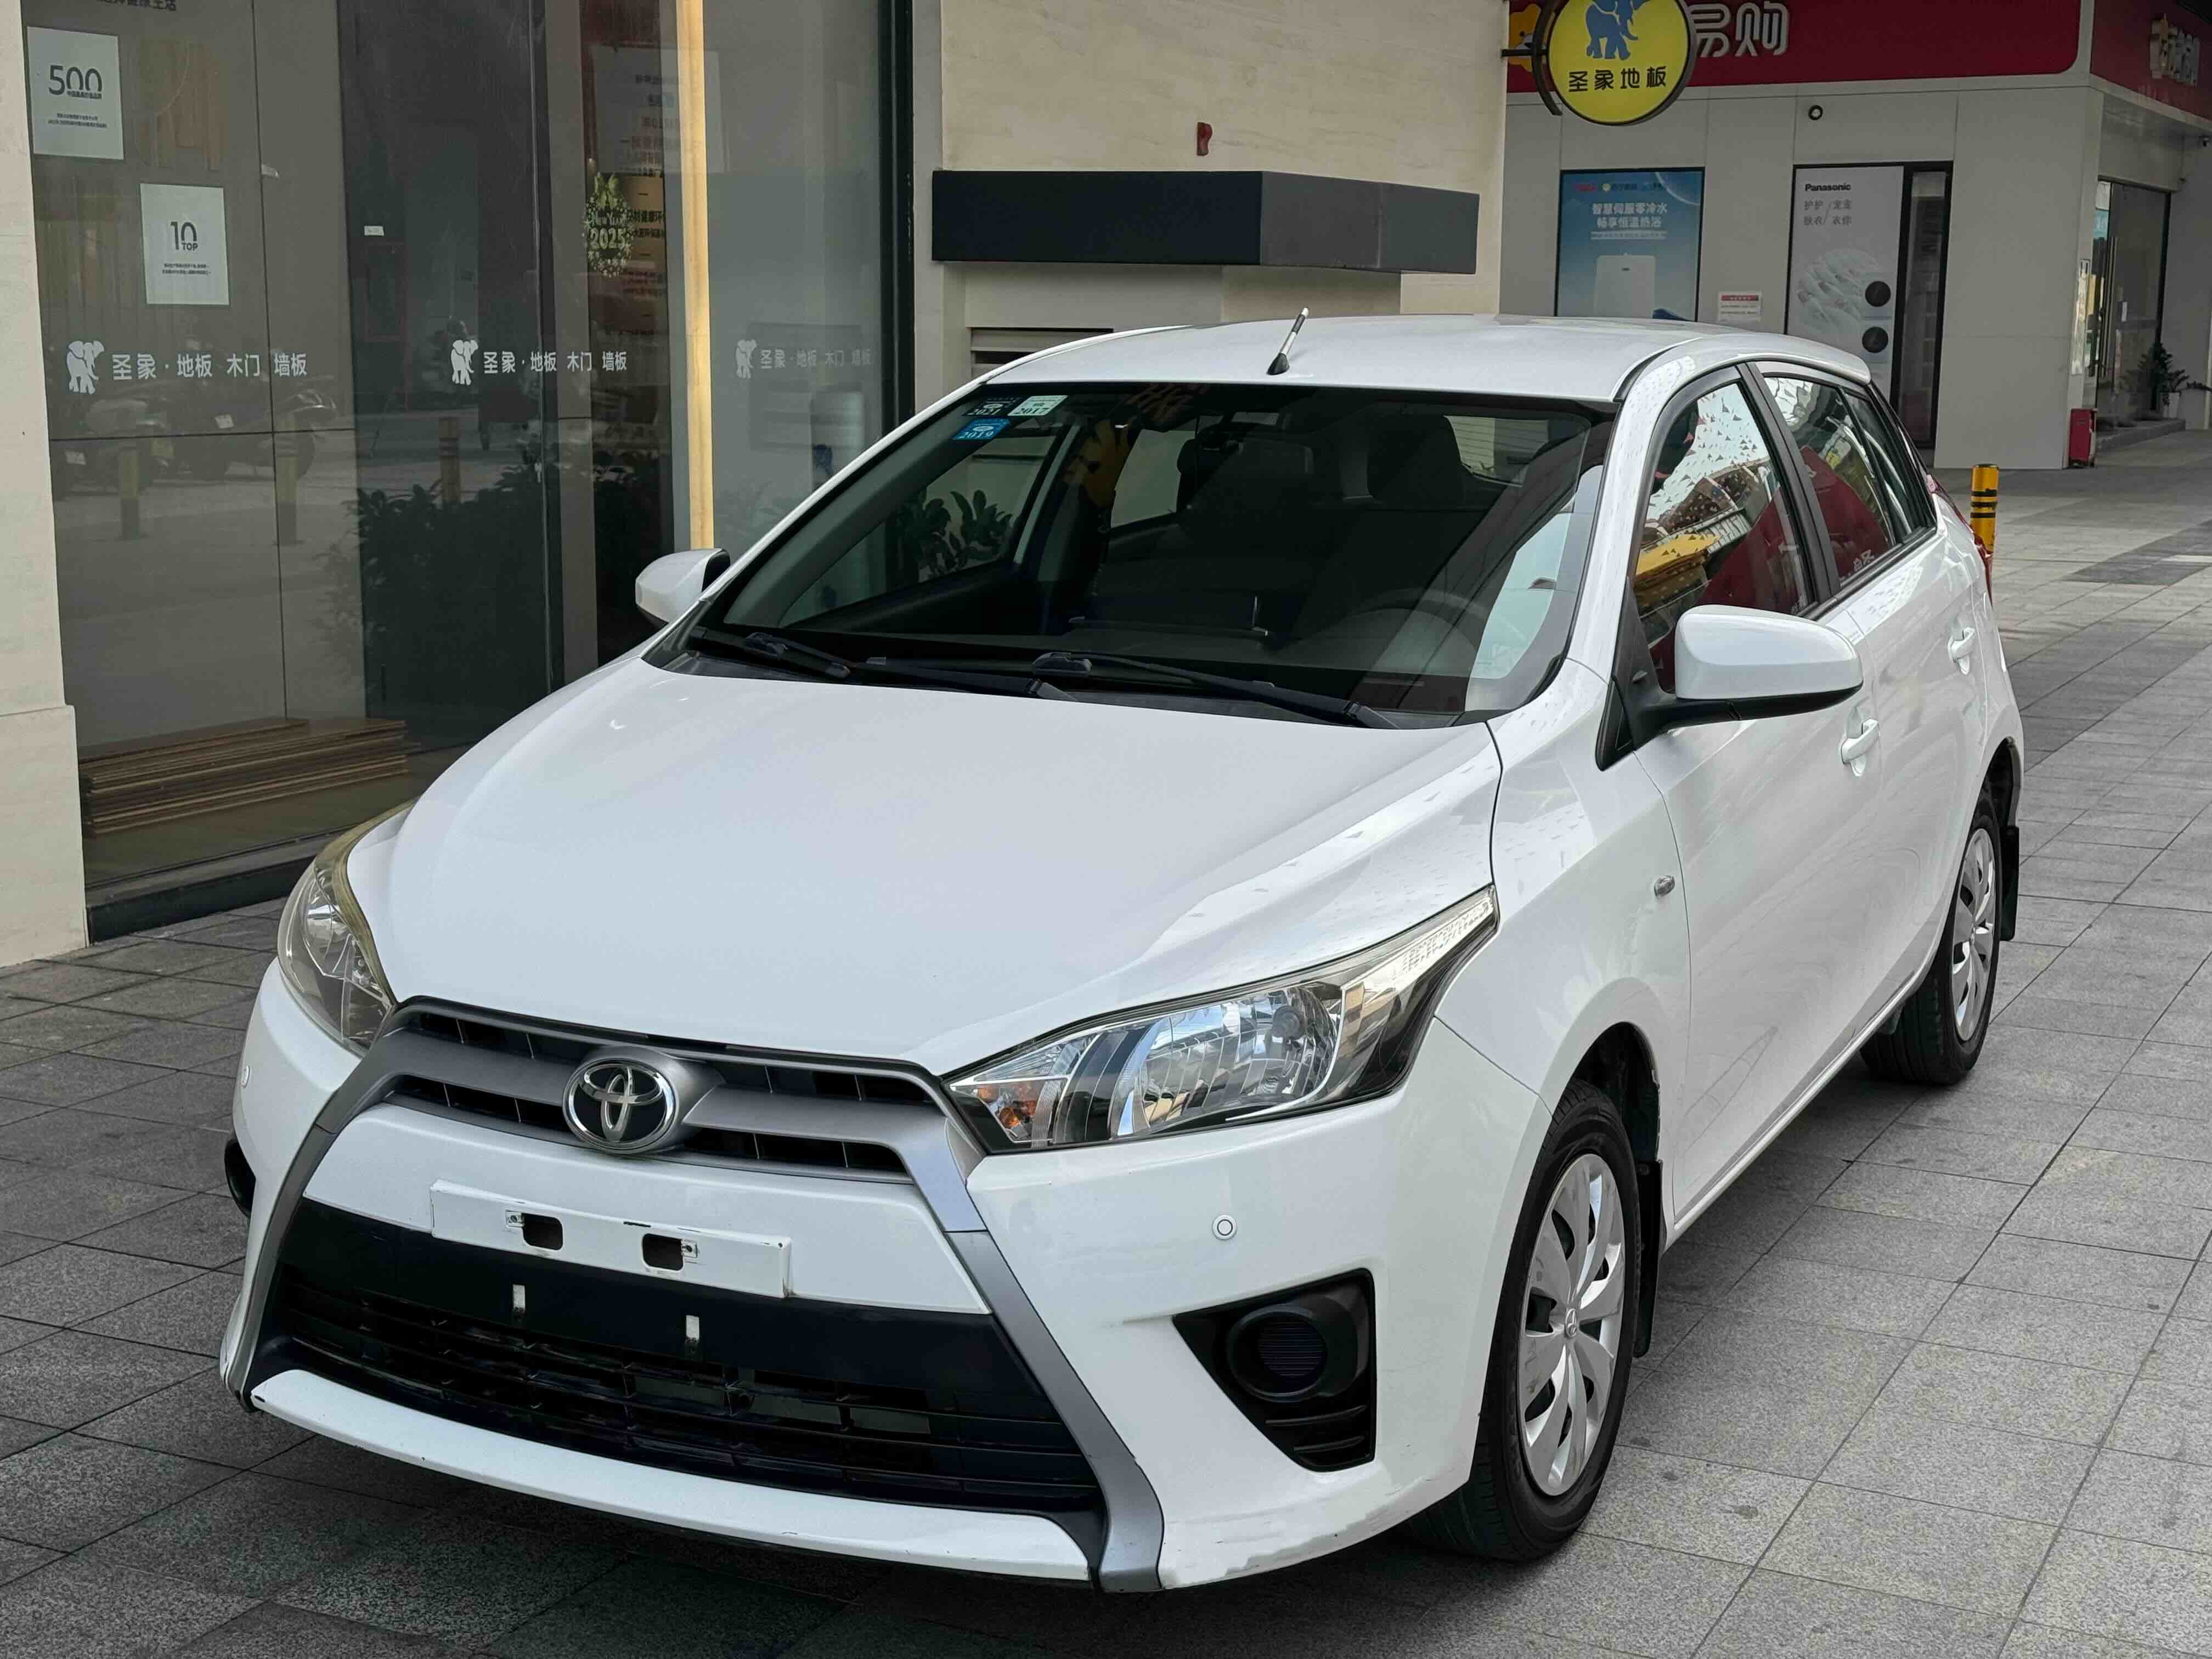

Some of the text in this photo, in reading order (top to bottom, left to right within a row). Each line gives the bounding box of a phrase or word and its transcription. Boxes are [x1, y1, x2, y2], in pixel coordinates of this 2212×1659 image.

[1688, 1, 1790, 58] 易购
[48, 65, 102, 95] 500
[1568, 66, 1667, 92] 圣象地板
[1805, 183, 1852, 191] Panasonic
[170, 221, 197, 250] 10
[181, 242, 198, 251] TOP
[590, 227, 626, 249] 2025
[227, 353, 261, 377] 木门
[274, 353, 307, 377] 墙板
[567, 351, 592, 371] 木门
[602, 351, 627, 371] 墙板
[1017, 407, 1051, 415] 2017
[958, 430, 994, 439] 2019
